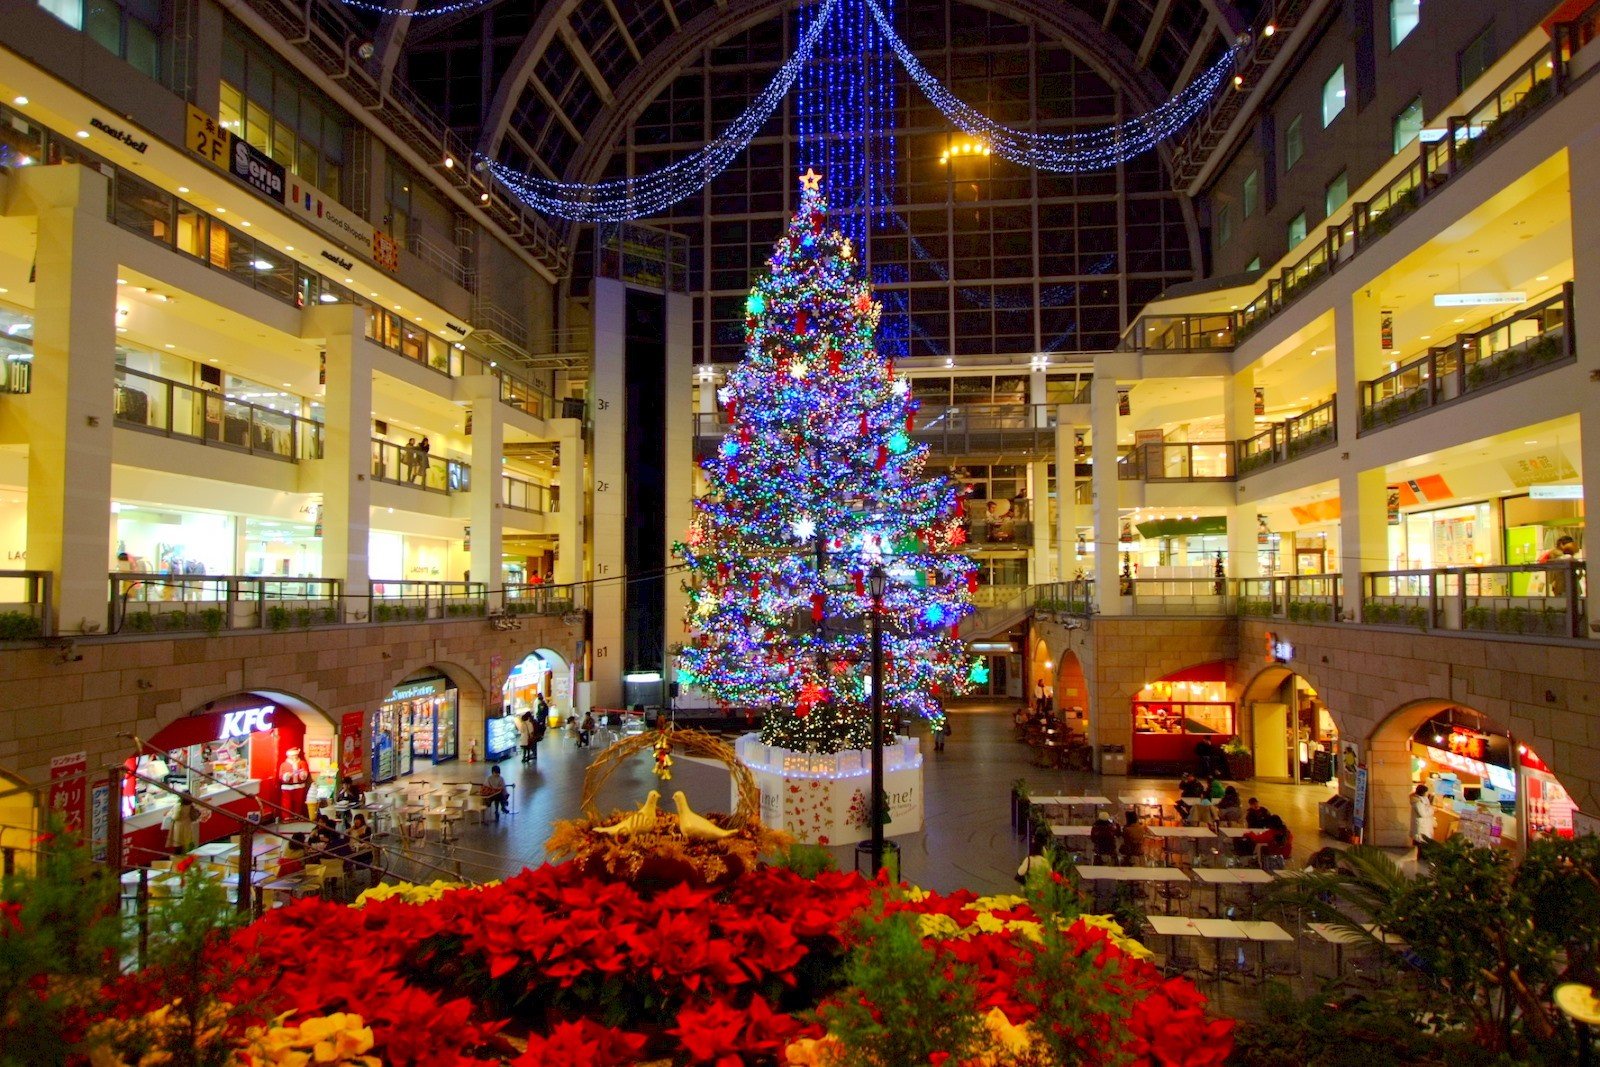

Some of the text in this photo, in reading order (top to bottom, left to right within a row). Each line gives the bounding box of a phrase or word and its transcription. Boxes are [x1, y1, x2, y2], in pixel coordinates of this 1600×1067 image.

[197, 131, 222, 161] 2F
[235, 141, 281, 192] Seria
[597, 398, 610, 411] 3F
[597, 480, 610, 492] 2F
[597, 563, 609, 574] 1F
[596, 646, 608, 657] B1
[219, 705, 276, 740] KFC
